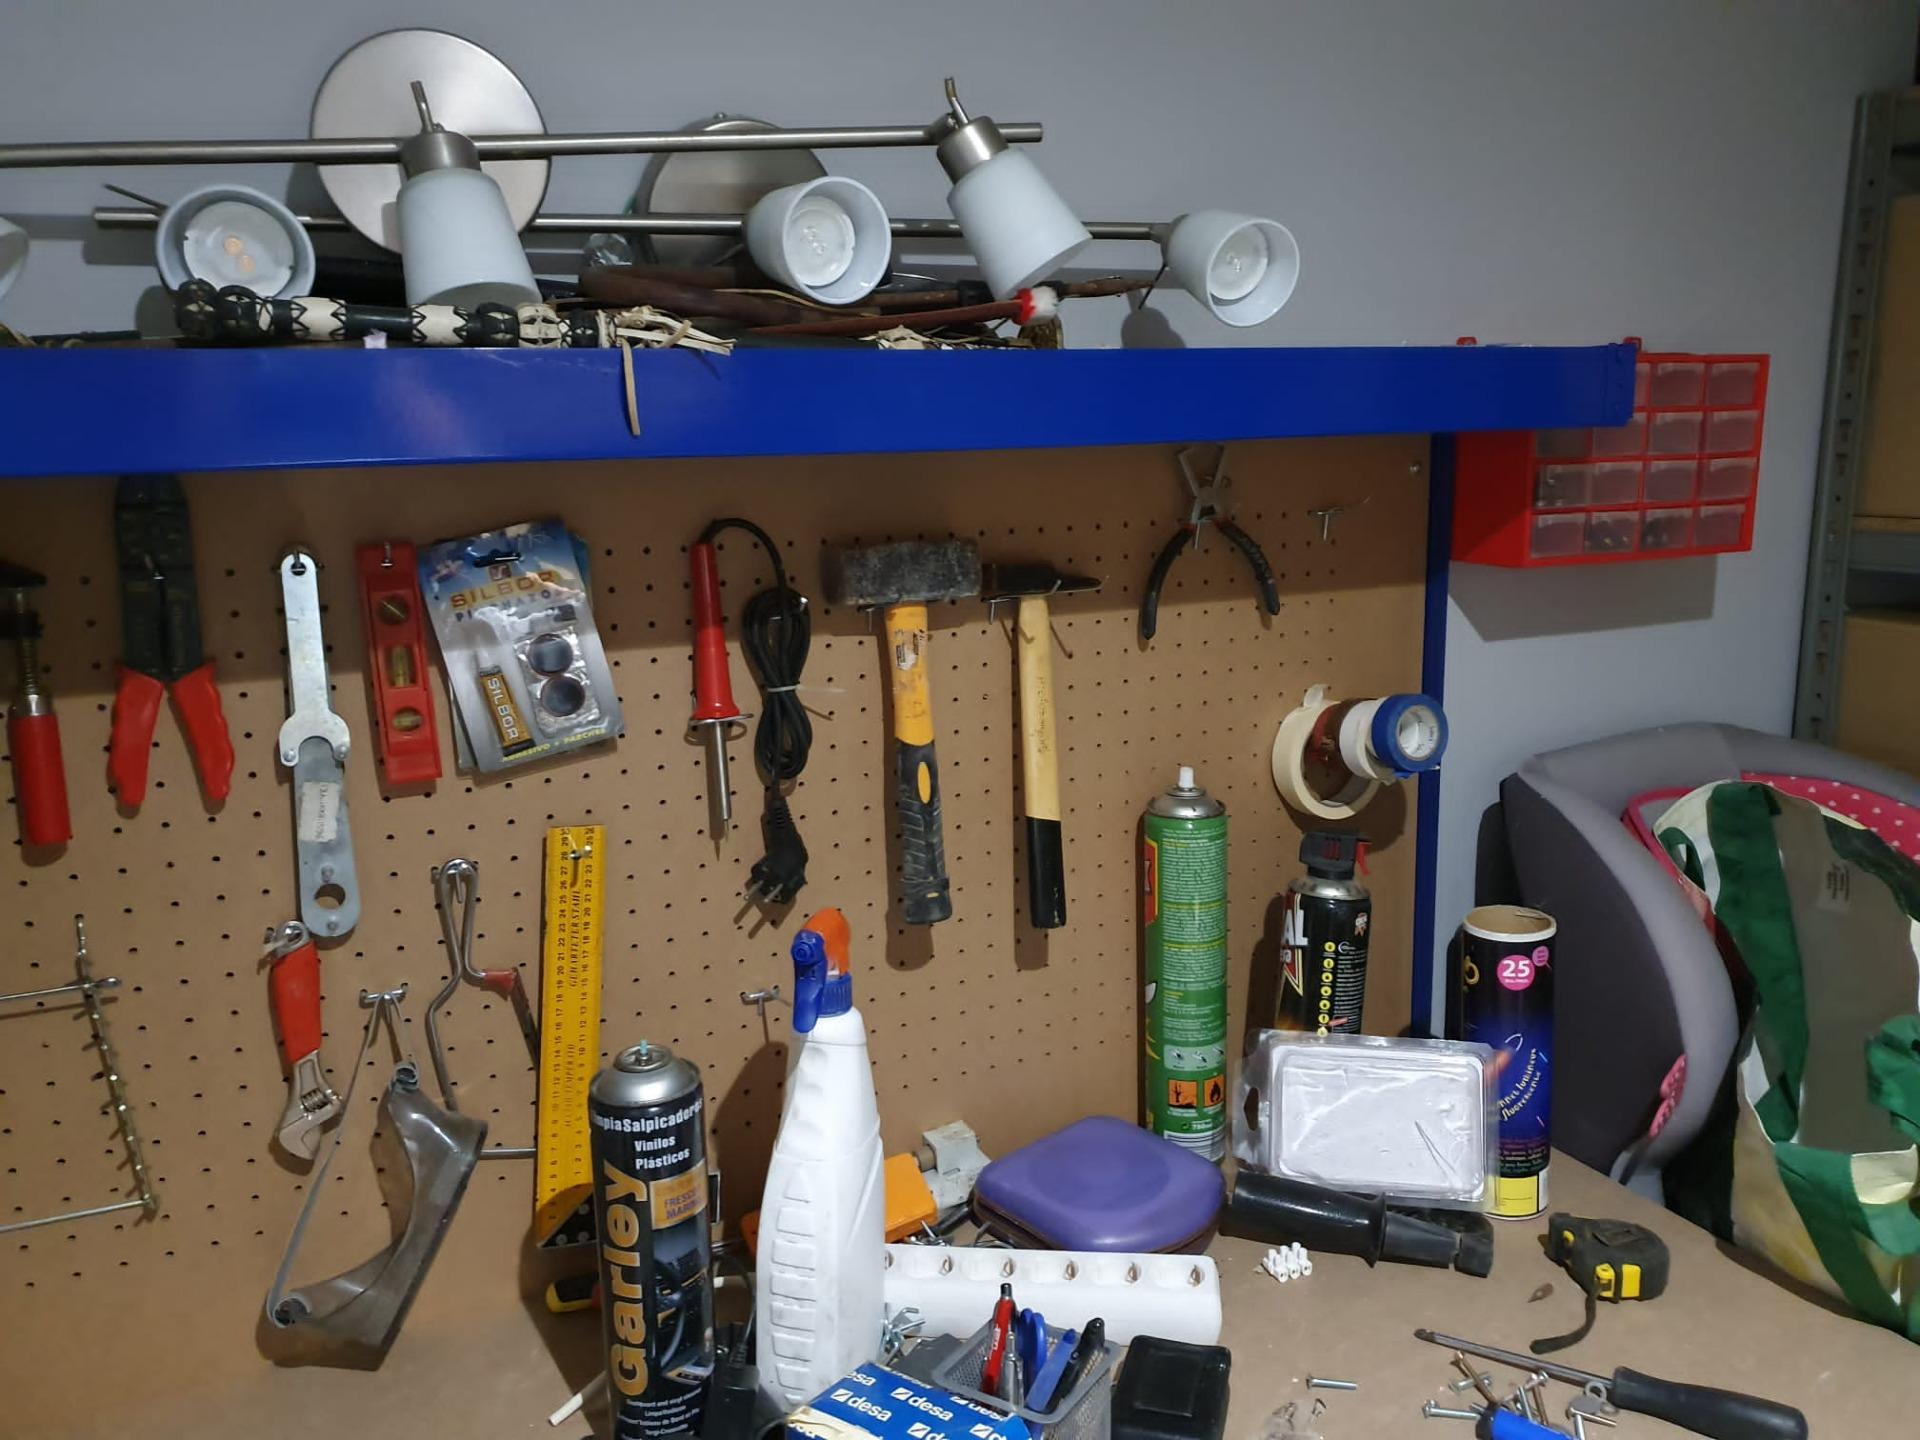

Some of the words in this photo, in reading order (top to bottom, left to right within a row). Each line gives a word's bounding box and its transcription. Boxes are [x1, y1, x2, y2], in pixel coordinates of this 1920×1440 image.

[452, 570, 554, 607] SILBOR
[487, 677, 519, 740] SILBOR
[560, 866, 568, 875] 27
[585, 865, 592, 874] 23
[585, 879, 592, 888] 22
[584, 894, 591, 902] 21
[559, 909, 566, 918] 24
[583, 907, 591, 916] 20
[558, 923, 566, 932] 23
[558, 938, 565, 947] 22
[557, 952, 565, 960] 21
[556, 966, 564, 975] 20
[1502, 959, 1530, 977] 25
[556, 1008, 562, 1016] 17
[579, 1047, 586, 1056] 10
[634, 1136, 676, 1152] Vinilos
[602, 1160, 648, 1396] Garley
[848, 1371, 877, 1387] esa
[849, 1394, 893, 1422] desa
[907, 1393, 954, 1422] desa
